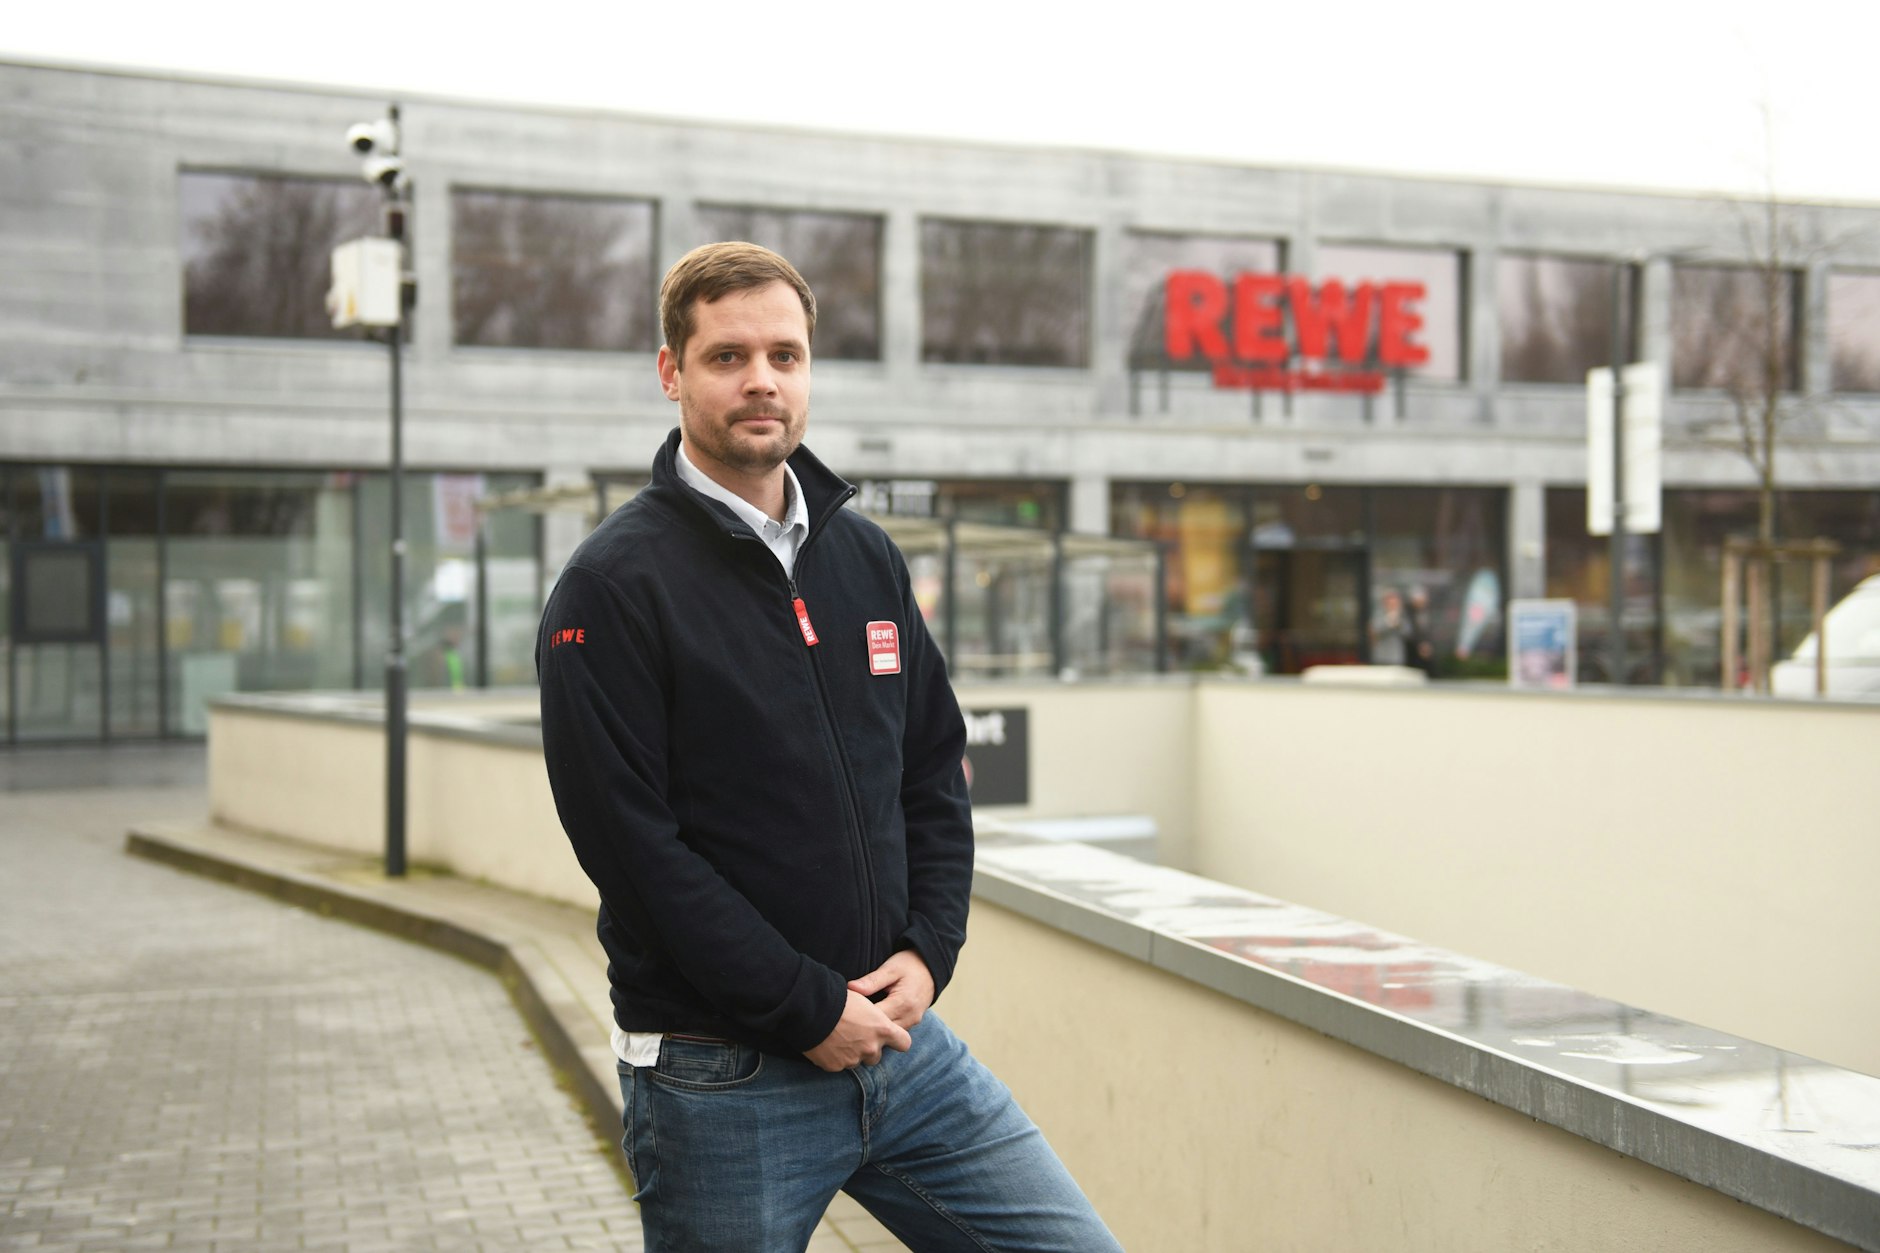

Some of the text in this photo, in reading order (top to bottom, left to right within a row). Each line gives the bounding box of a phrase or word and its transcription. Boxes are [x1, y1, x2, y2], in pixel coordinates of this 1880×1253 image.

[1164, 267, 1430, 366] REWE
[799, 616, 815, 642] REWE
[871, 629, 894, 640] REWE
